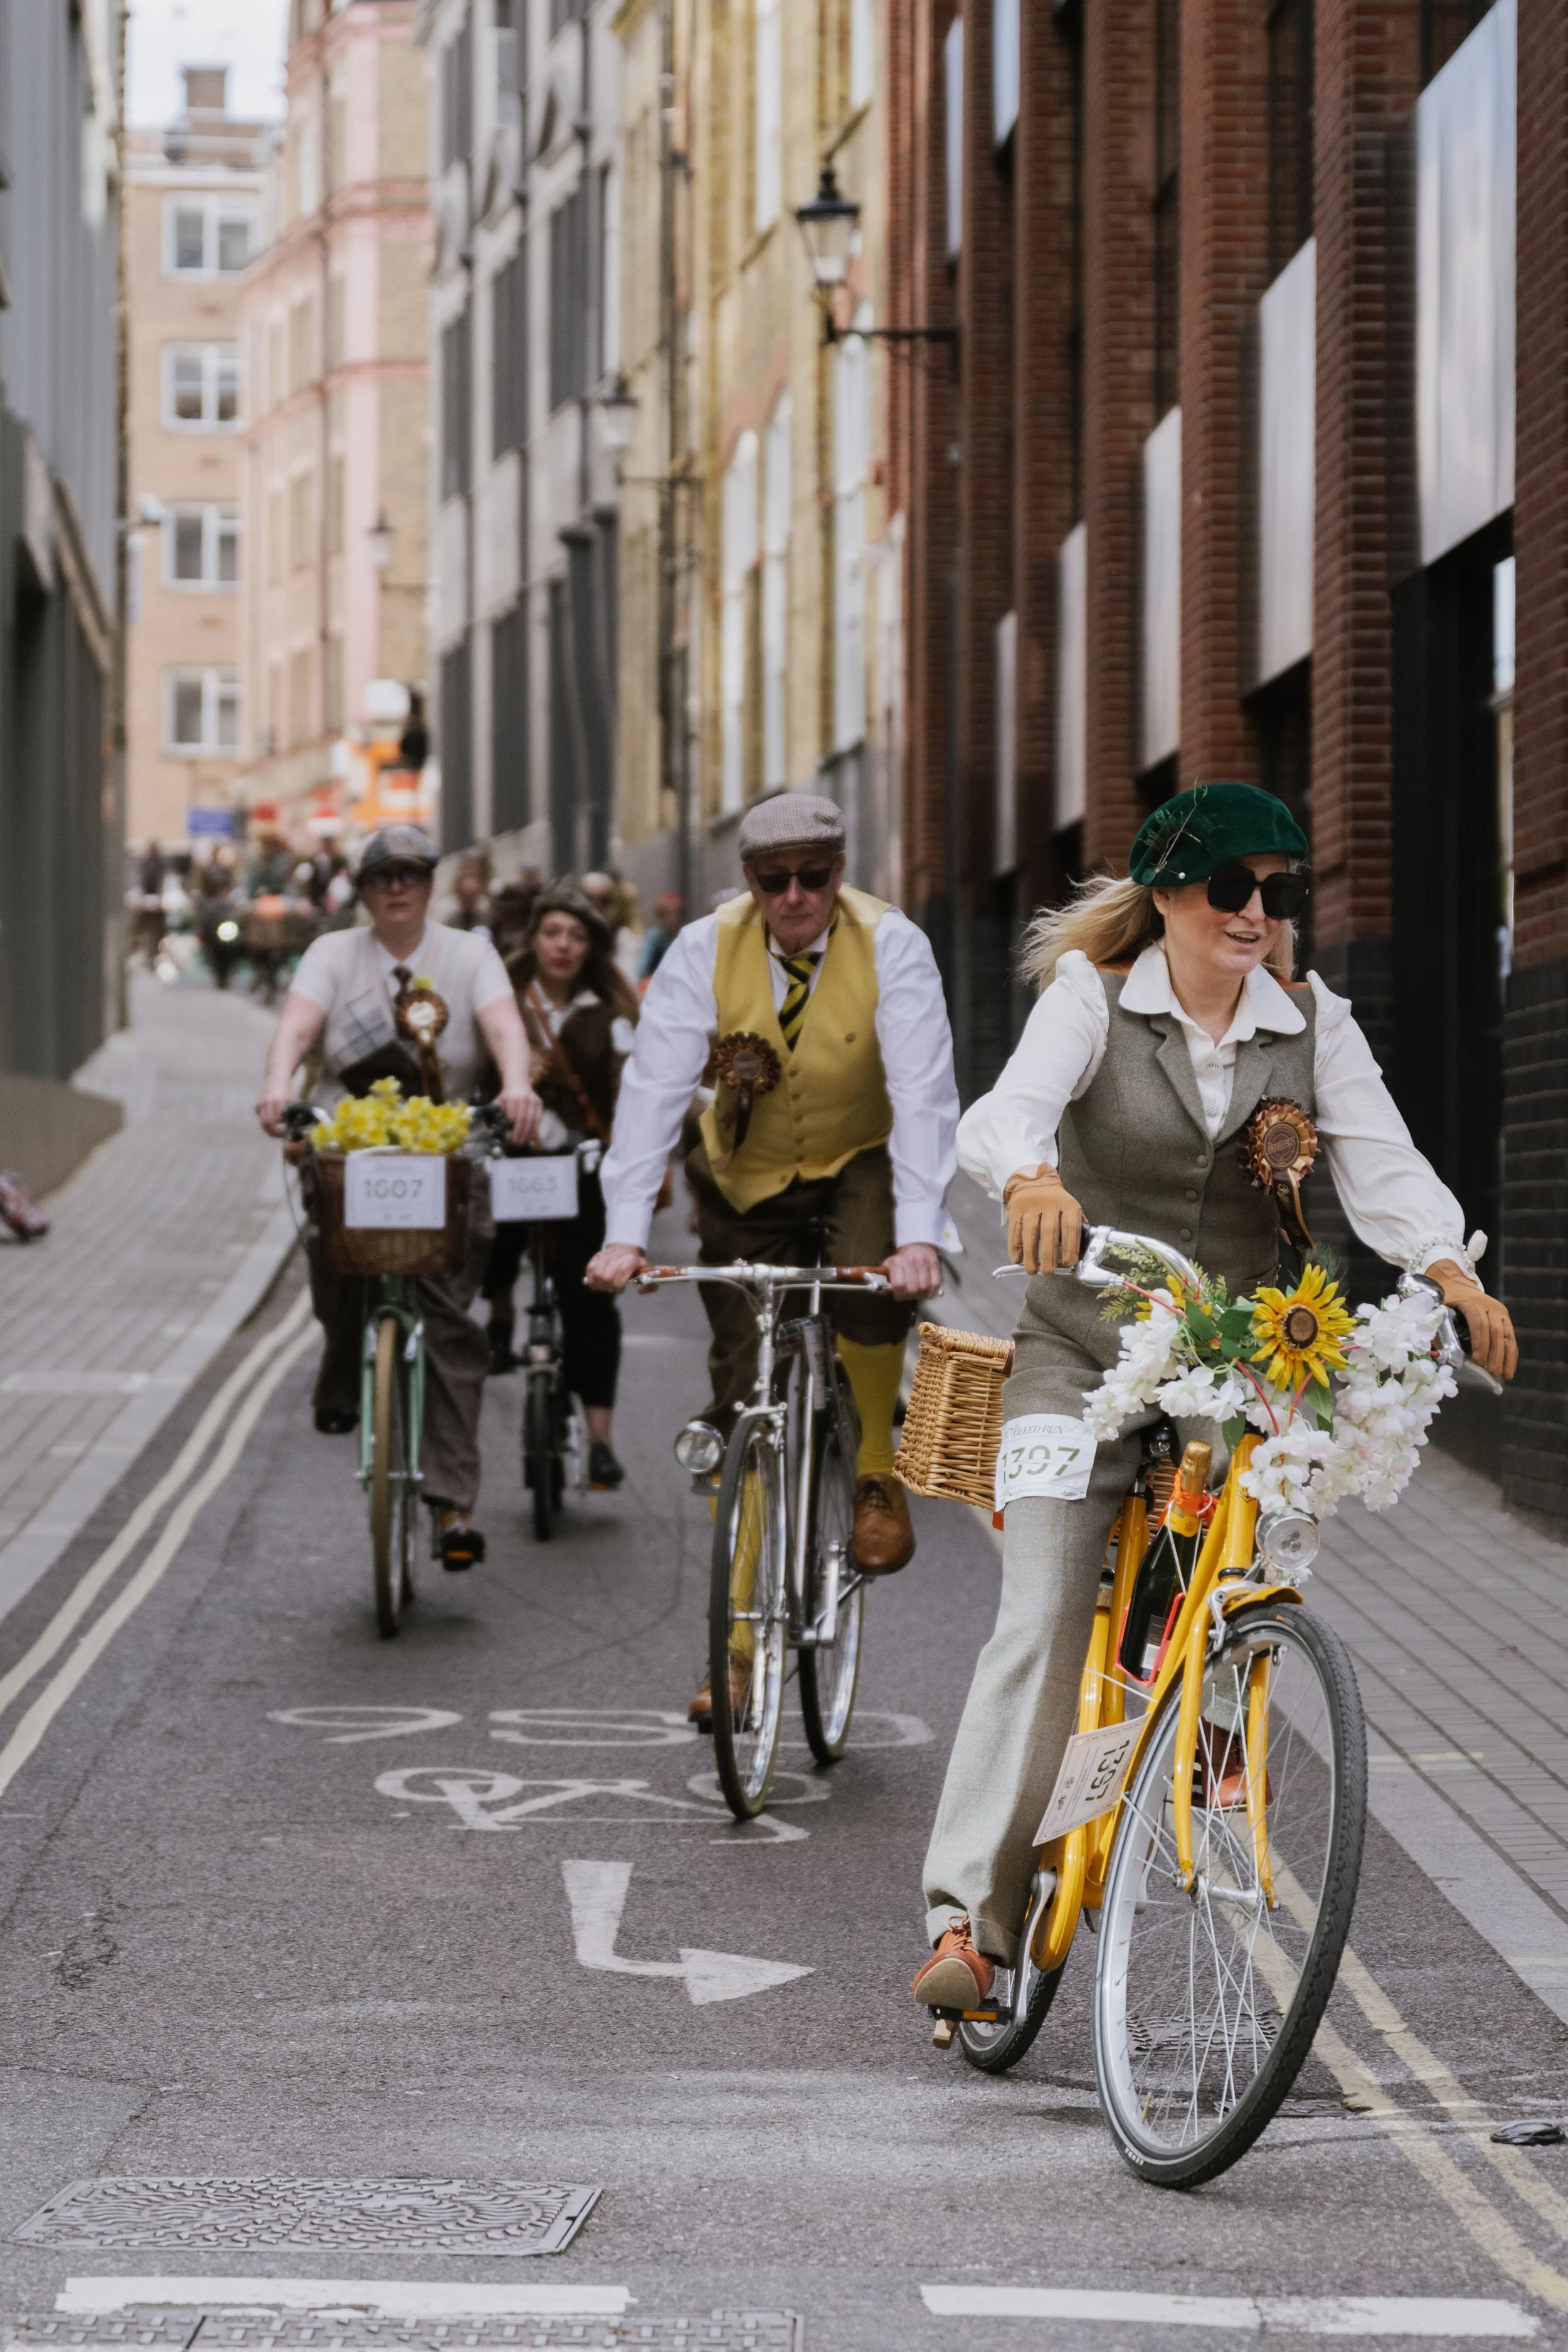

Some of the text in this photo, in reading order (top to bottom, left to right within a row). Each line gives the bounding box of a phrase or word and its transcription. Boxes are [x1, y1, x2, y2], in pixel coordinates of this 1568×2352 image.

[363, 1179, 424, 1199] 1607
[1041, 1424, 1062, 1434] RUN
[1002, 1444, 1080, 1484] 1397
[1084, 1739, 1130, 1801] 1397
